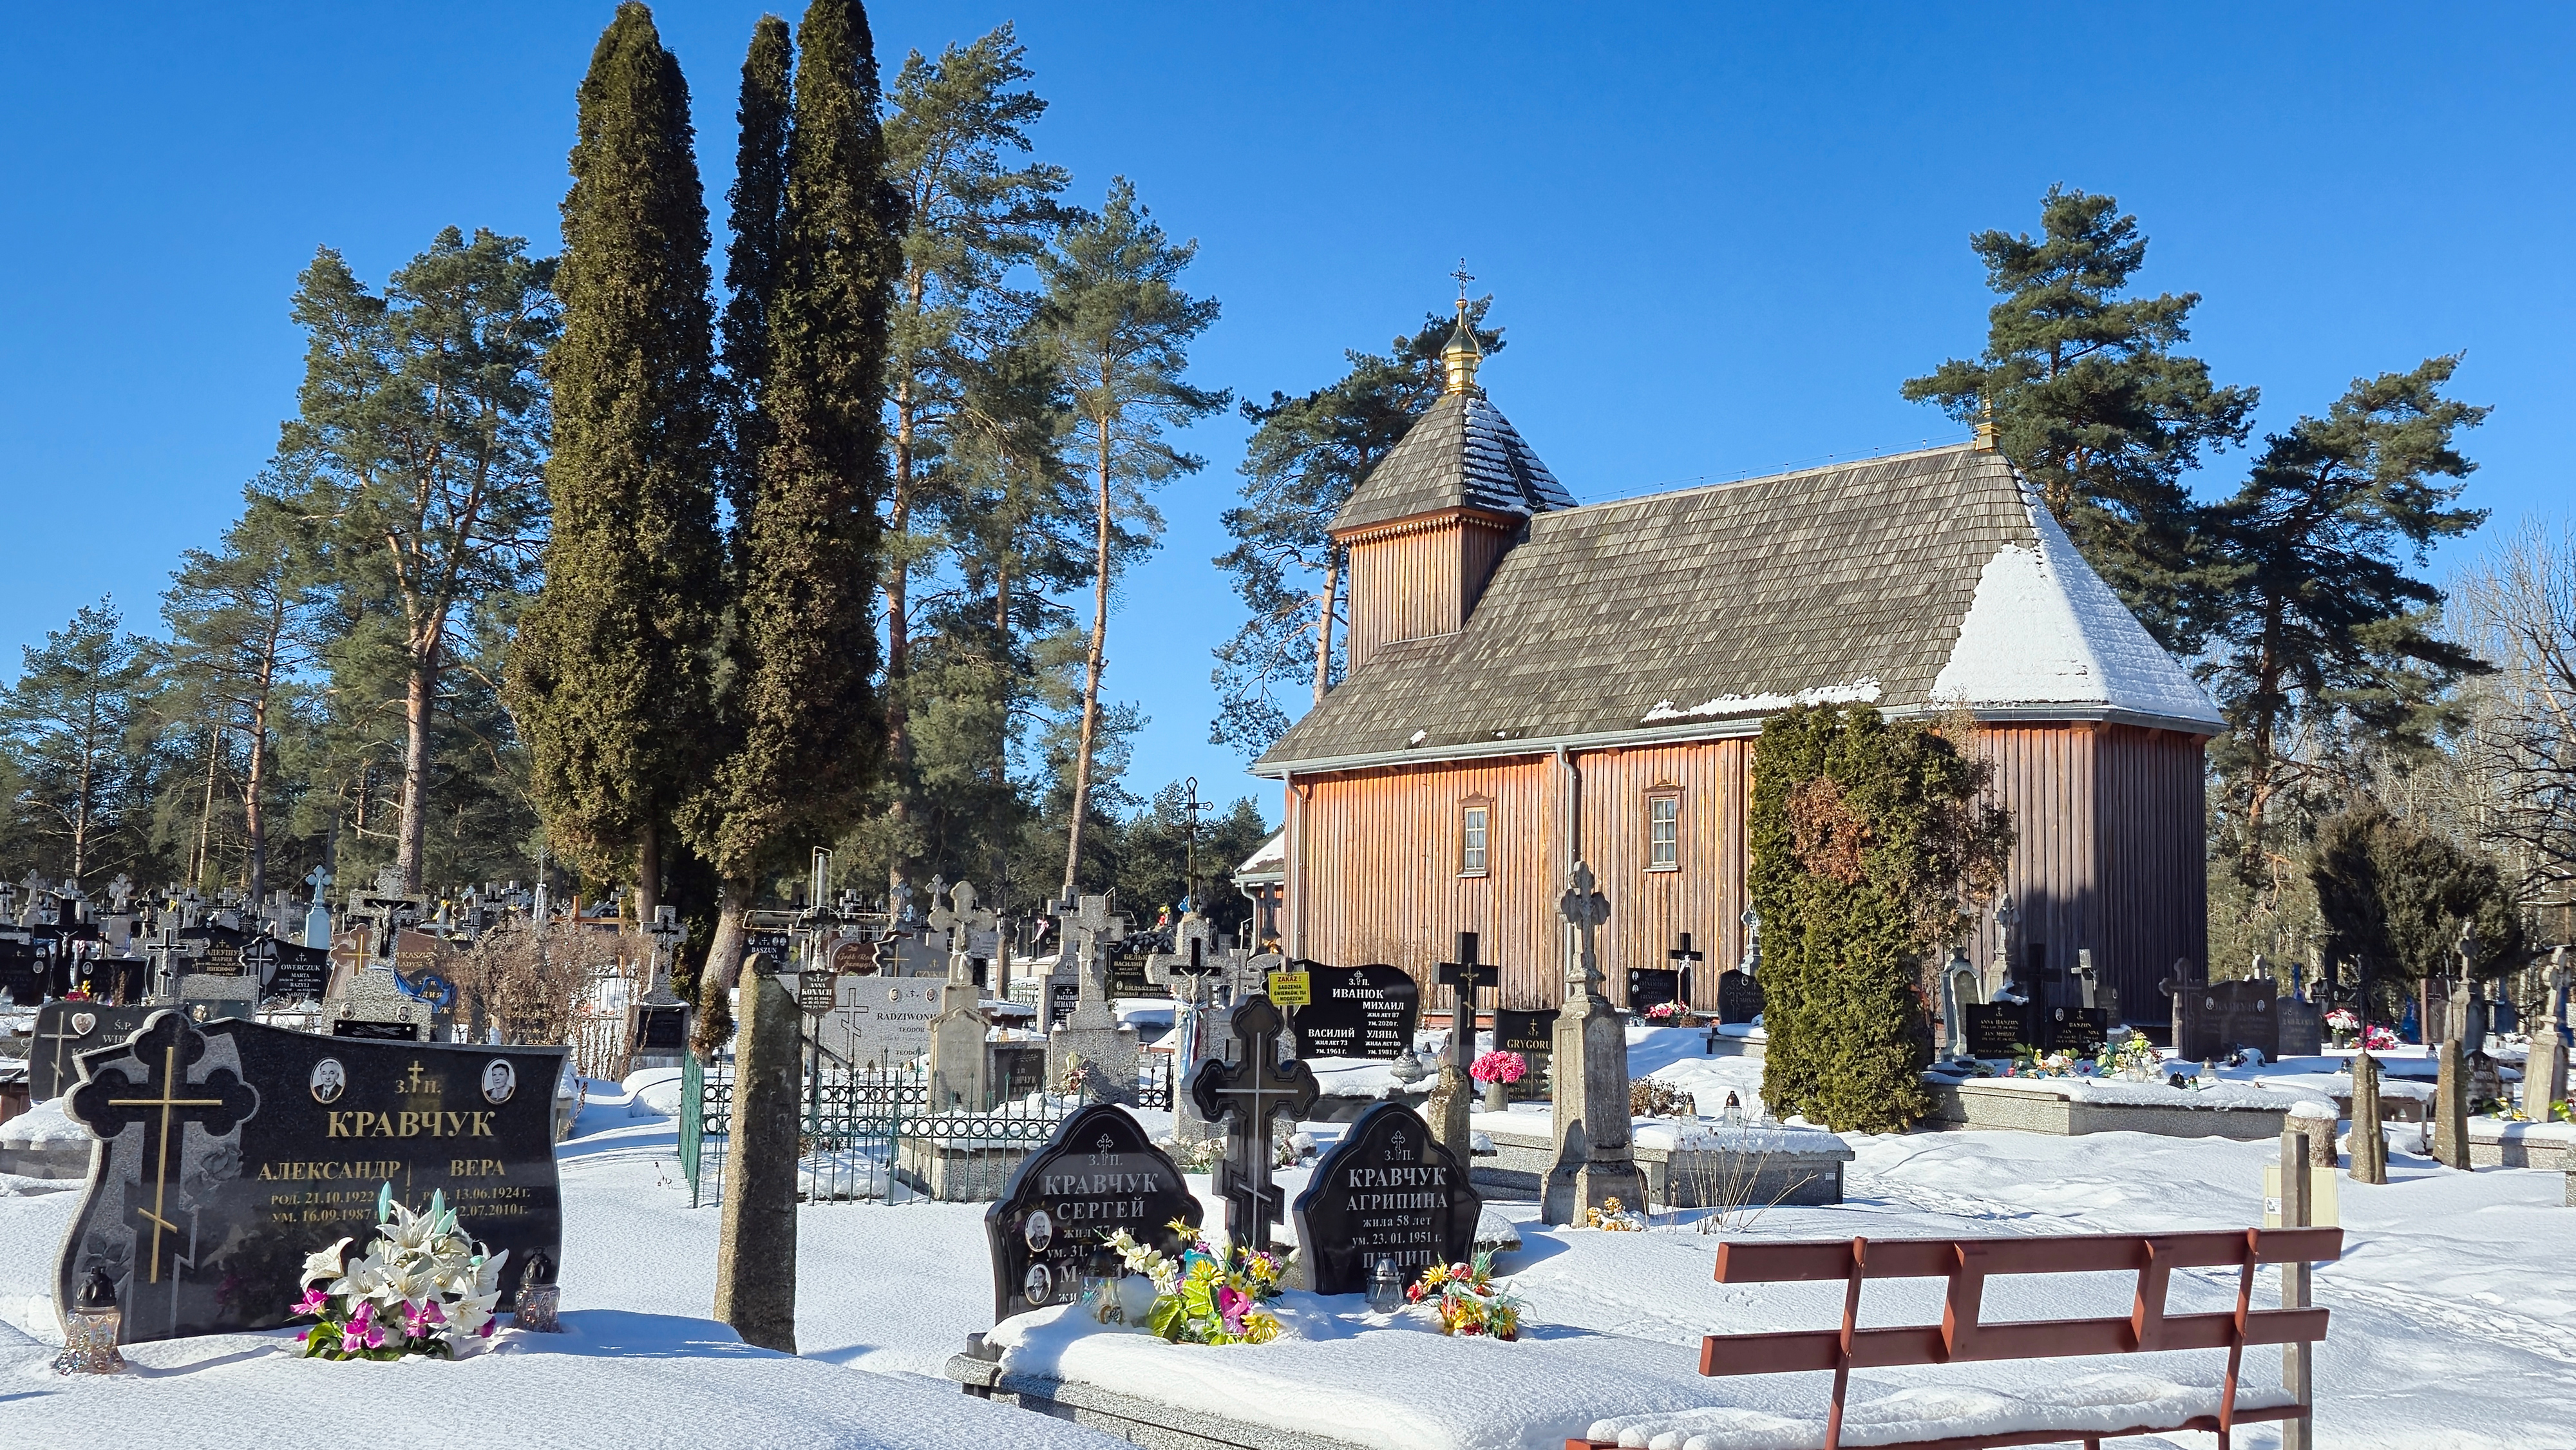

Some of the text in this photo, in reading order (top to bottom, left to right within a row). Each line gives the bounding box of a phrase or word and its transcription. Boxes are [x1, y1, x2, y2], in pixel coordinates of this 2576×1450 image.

[1332, 988, 1384, 998] ИВАНЮК
[1363, 1002, 1405, 1011] МИХАИЛ
[876, 1013, 936, 1021] RADZIWONI
[1308, 1028, 1399, 1039] ВАСИЛИЙ УЛЯНА
[1507, 1038, 1551, 1050] GRYGORU
[395, 1079, 442, 1094] З. П.
[325, 1110, 497, 1139] КРАВЧУК
[1088, 1154, 1123, 1166] З. П.
[1385, 1150, 1414, 1161] З. П.
[258, 1159, 506, 1182] АЛЕКСАНДР ВЕРА
[1349, 1167, 1446, 1188] КРАВЧУК
[1044, 1173, 1159, 1196] КРАВЧУК
[305, 1190, 375, 1205] 21.10.1922
[456, 1187, 520, 1200] 13.06.1924
[1056, 1196, 1144, 1220] СЕРГЕЙ
[1346, 1192, 1448, 1211] АГРИПИНА
[303, 1208, 372, 1222] 16.09.1987
[459, 1203, 517, 1217] 2.07.2010
[1363, 1214, 1432, 1228] жила 58 лет
[1064, 1228, 1092, 1239] жил
[1352, 1236, 1369, 1249] ум.
[1372, 1233, 1387, 1245] 23.
[1390, 1232, 1405, 1244] 01.
[1410, 1231, 1431, 1243] 1951
[1046, 1248, 1066, 1261] ум.
